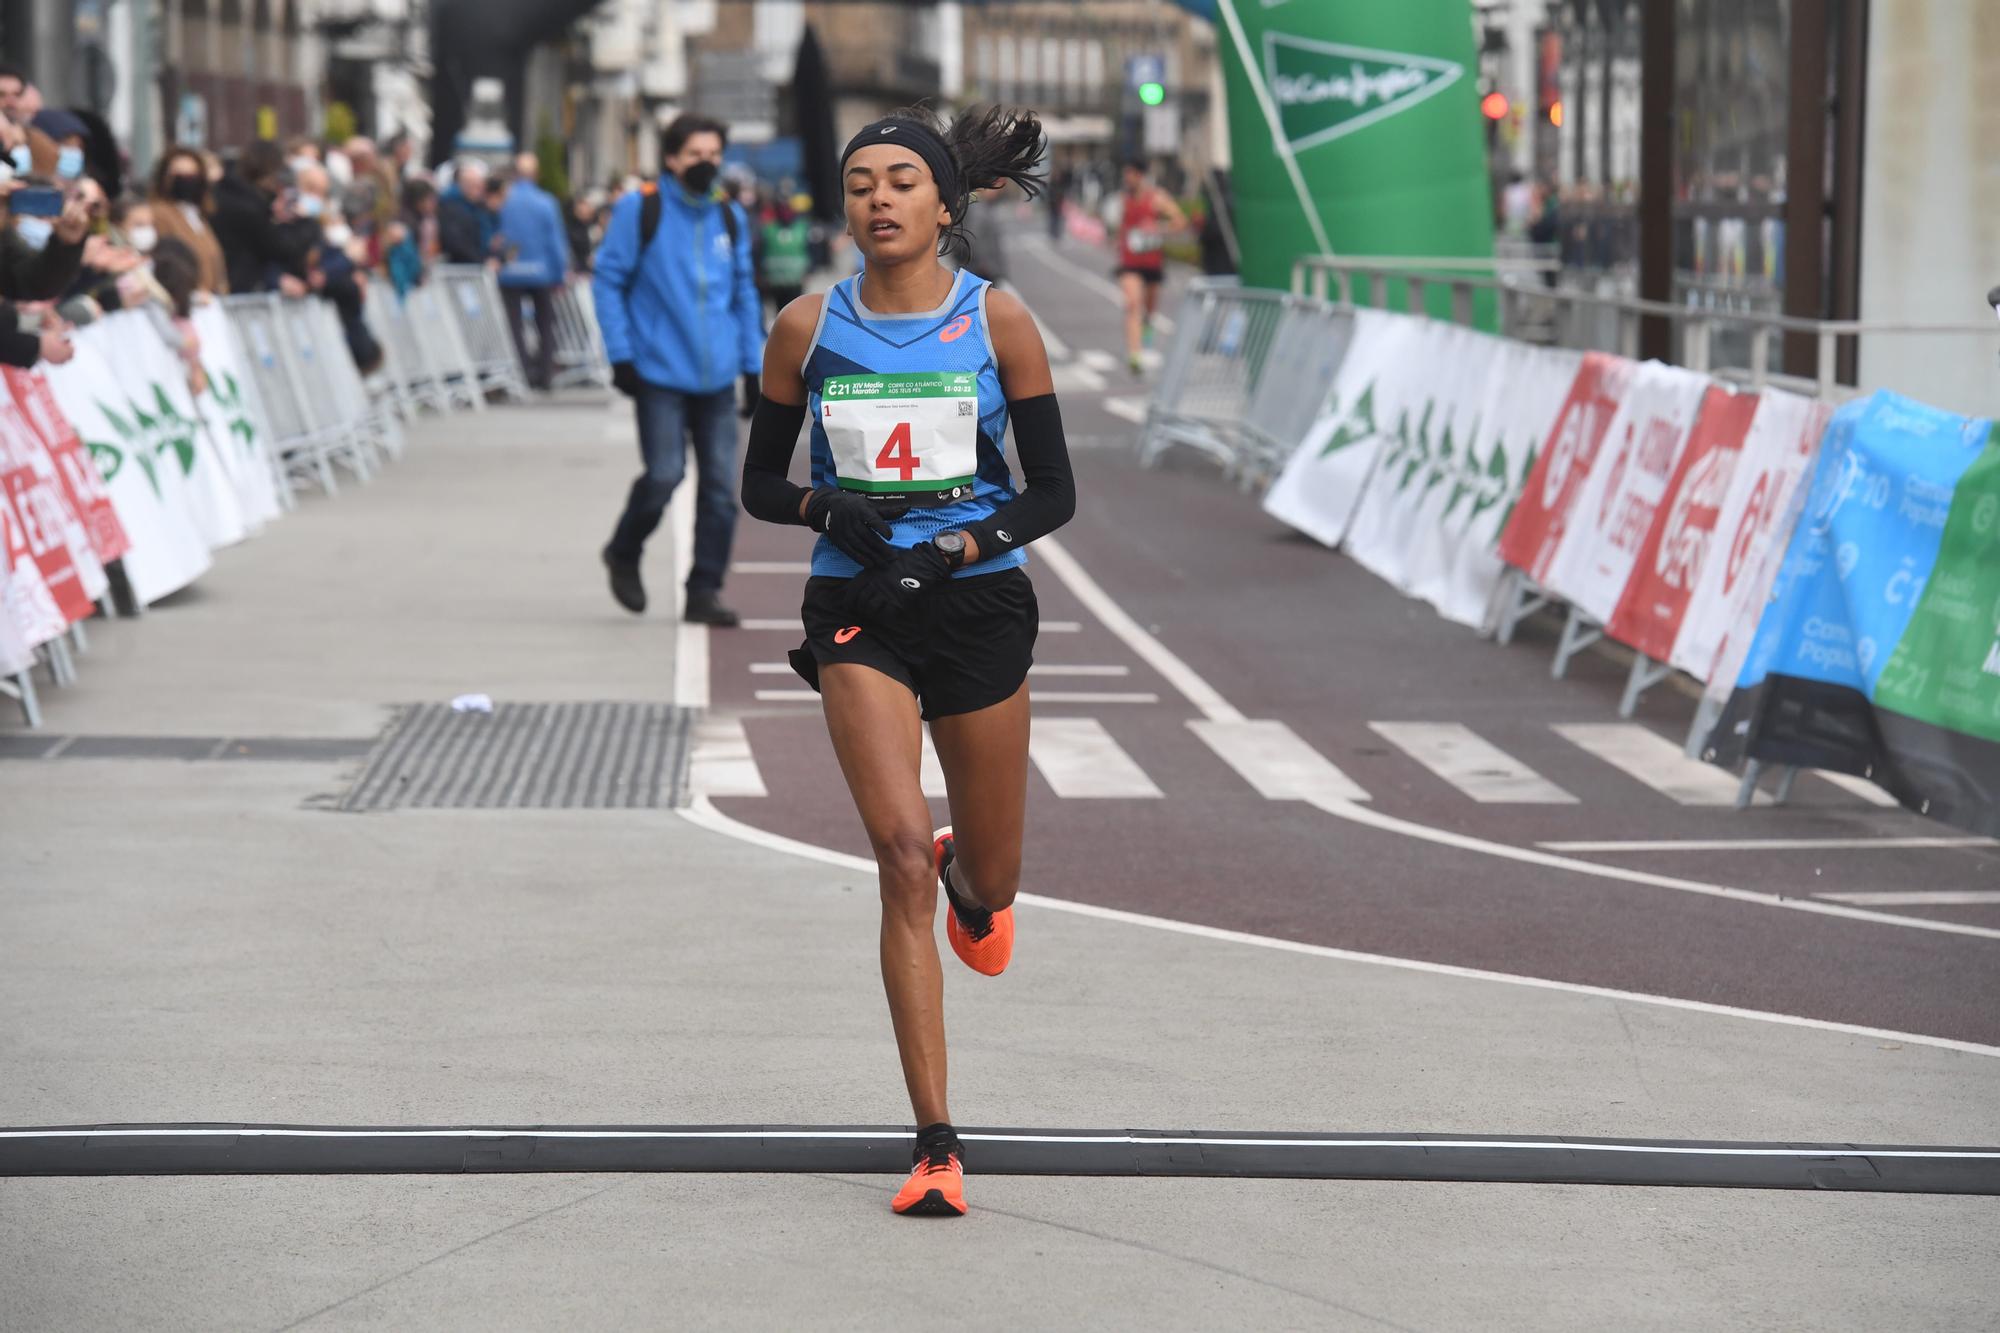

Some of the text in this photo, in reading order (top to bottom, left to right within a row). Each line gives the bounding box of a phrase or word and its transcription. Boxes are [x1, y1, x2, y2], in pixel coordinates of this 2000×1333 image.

[852, 387, 880, 395] Maratón
[824, 405, 832, 417] 1
[875, 422, 921, 481] 4
